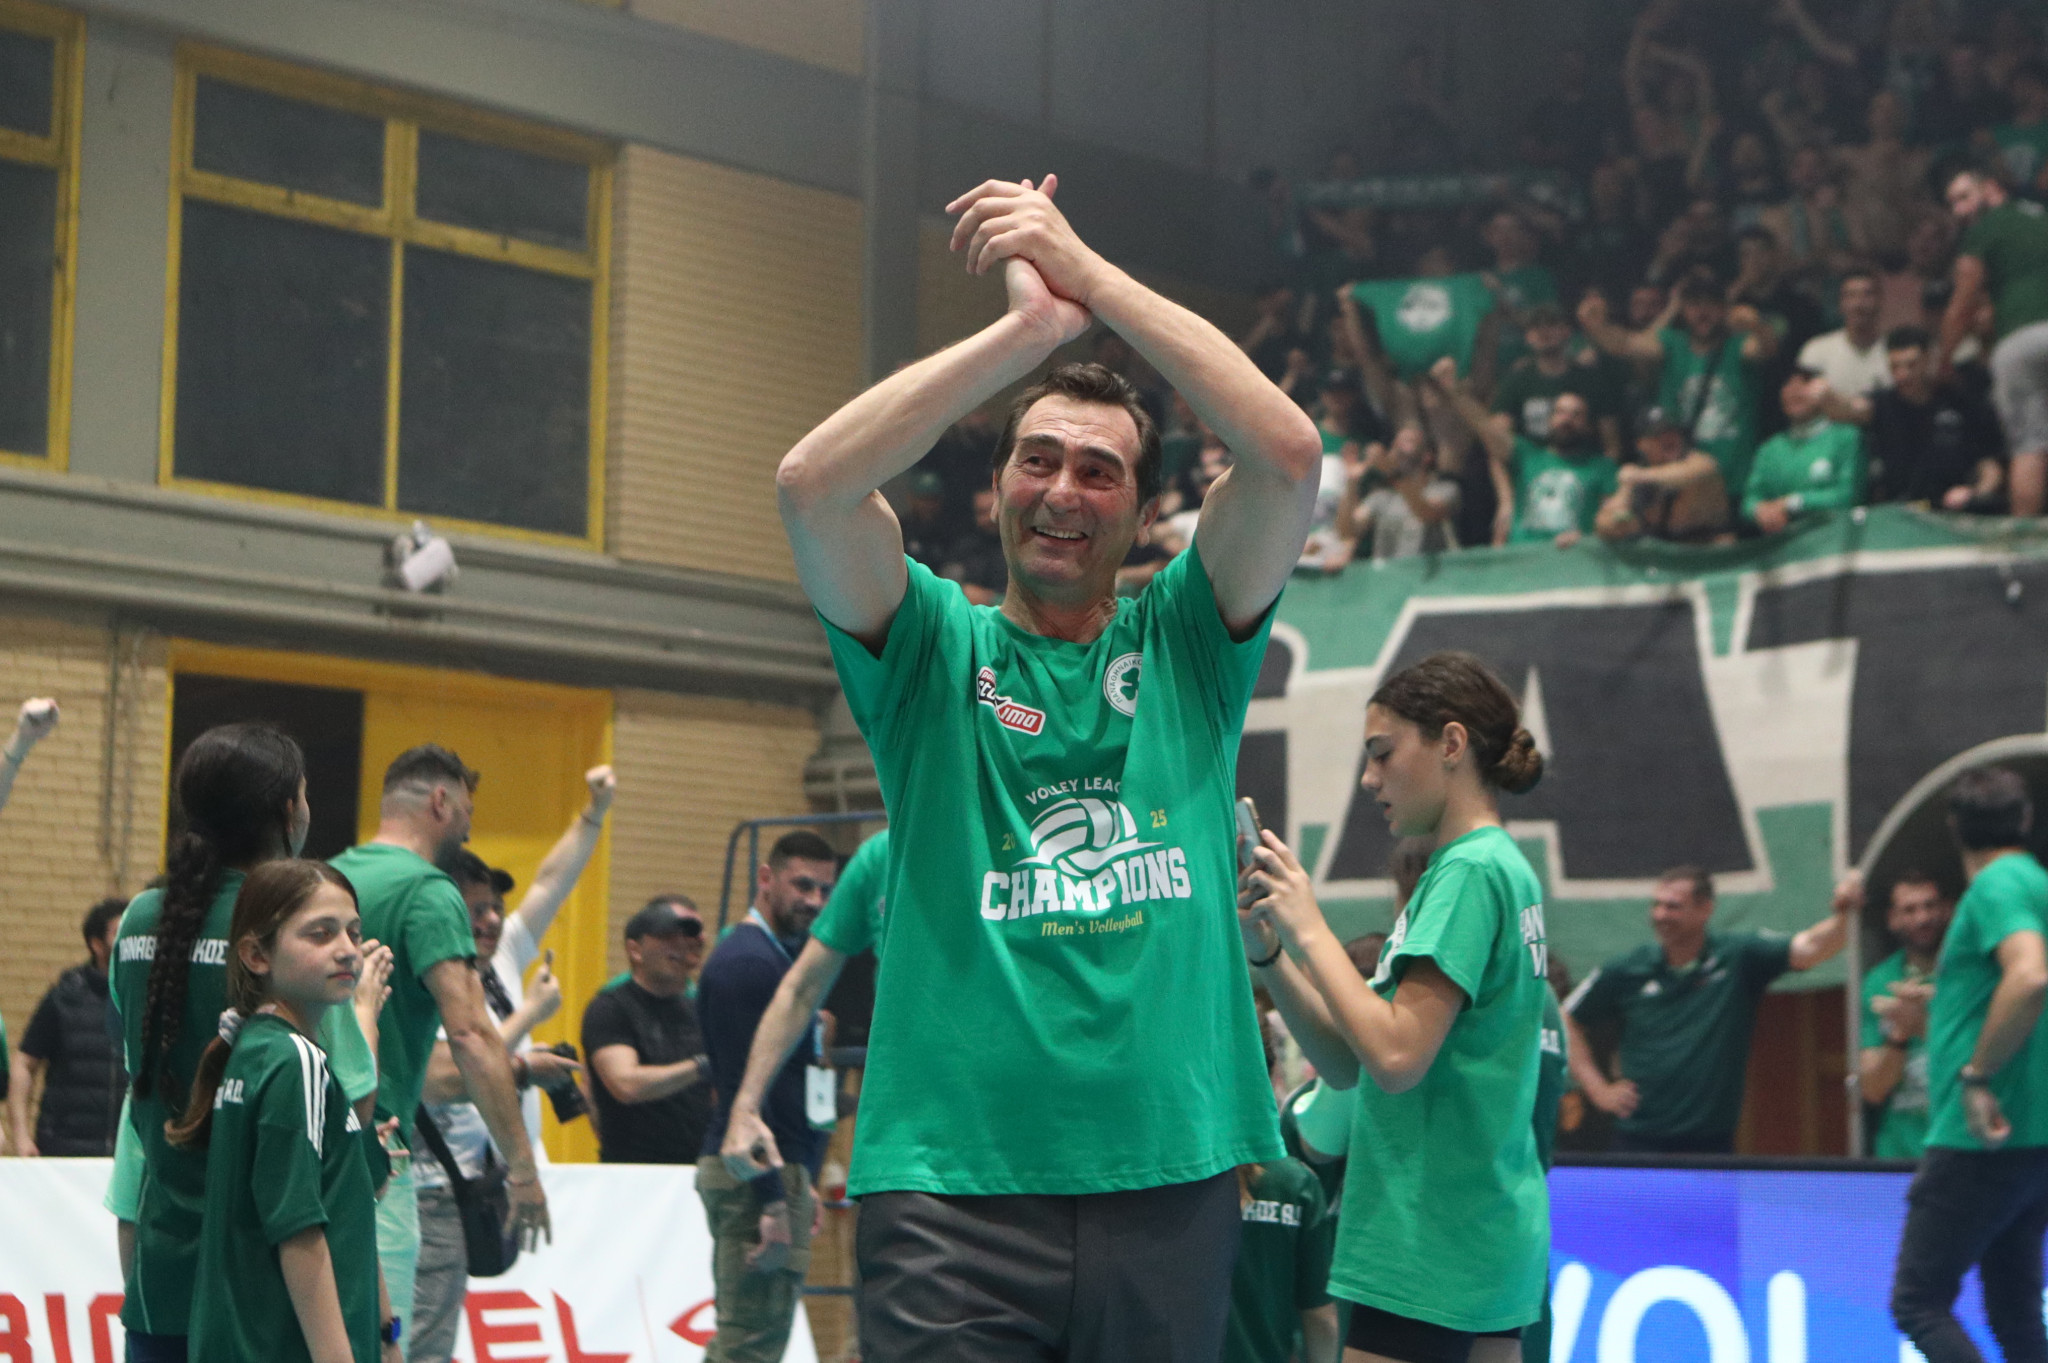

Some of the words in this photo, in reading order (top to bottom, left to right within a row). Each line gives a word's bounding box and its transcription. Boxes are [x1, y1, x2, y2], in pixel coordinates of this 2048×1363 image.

[1025, 778, 1078, 805] VOLLEY
[1150, 808, 1168, 828] 25
[980, 847, 1192, 921] CHAMPIONS
[1041, 920, 1085, 937] Men's
[1089, 909, 1143, 934] Volleyball
